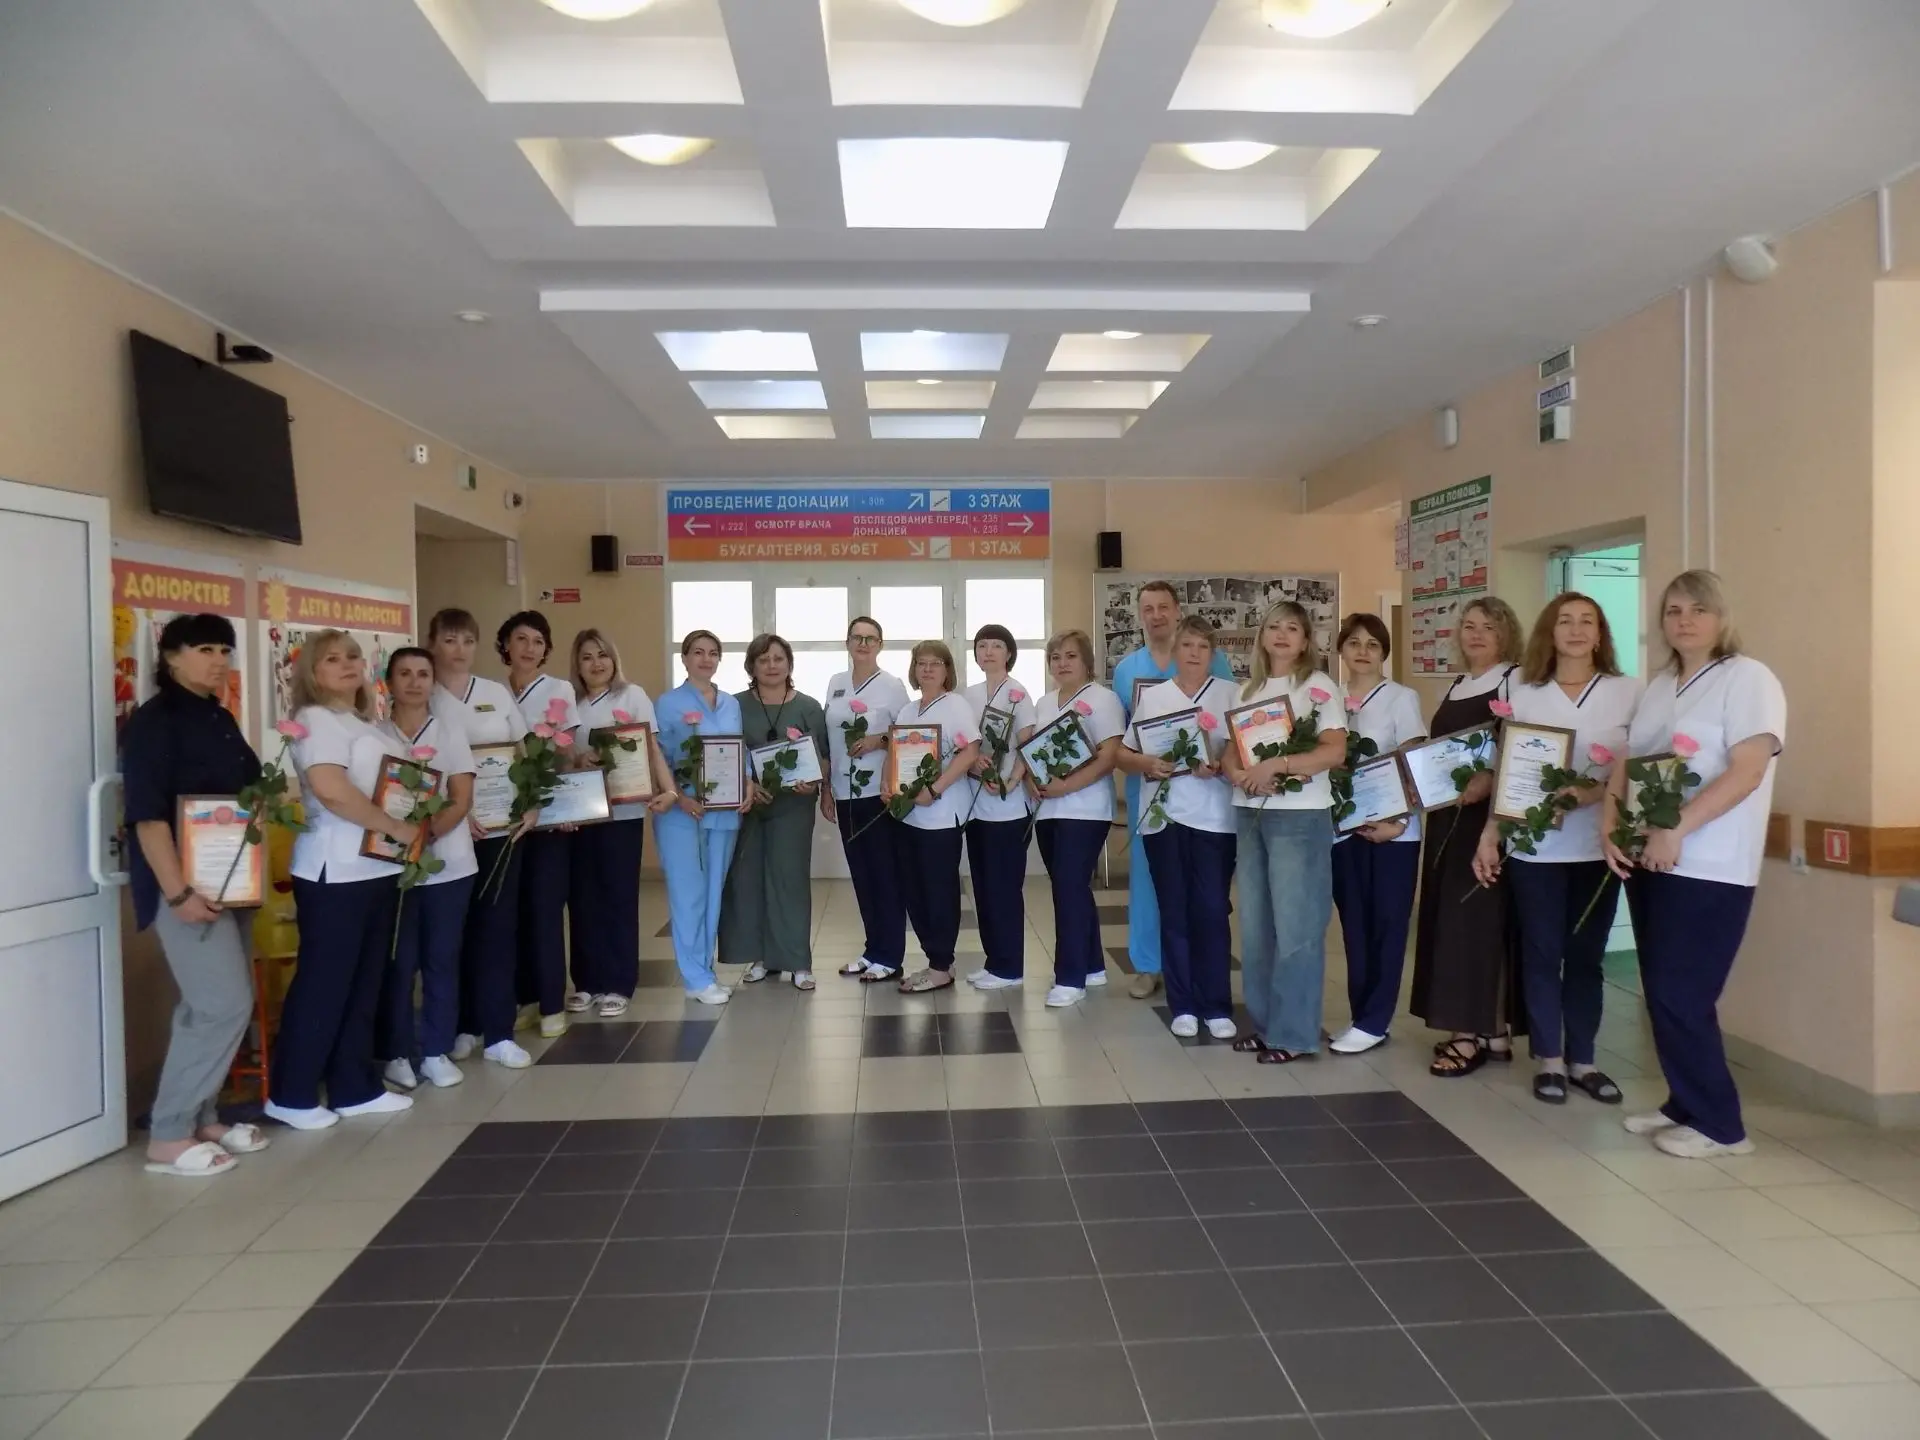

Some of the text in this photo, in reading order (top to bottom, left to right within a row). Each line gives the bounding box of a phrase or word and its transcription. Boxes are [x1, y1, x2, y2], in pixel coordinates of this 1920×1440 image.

[1446, 483, 1482, 503] ПОМОЩЬ
[673, 495, 773, 510] ПРОВЕДЕНИЕ
[777, 495, 849, 510] ДОНАЦИИ
[968, 494, 1022, 508] 3 ЭТАЖ
[754, 519, 832, 529] ОСМОТР ВРАЧА
[853, 515, 969, 525] ОБСЛЕДОВАНИЕ ПЕРЕД
[853, 526, 907, 536] ДОНАЦИЕЙ
[719, 541, 879, 557] БУХГАЛТЕРИЯ, БУФЕТ
[968, 540, 1022, 556] 1 ЭТАЖ
[124, 572, 231, 607] ДОНОРСТВЕ
[299, 597, 403, 626] ДЕТИ О ДОНОРСТВЕ
